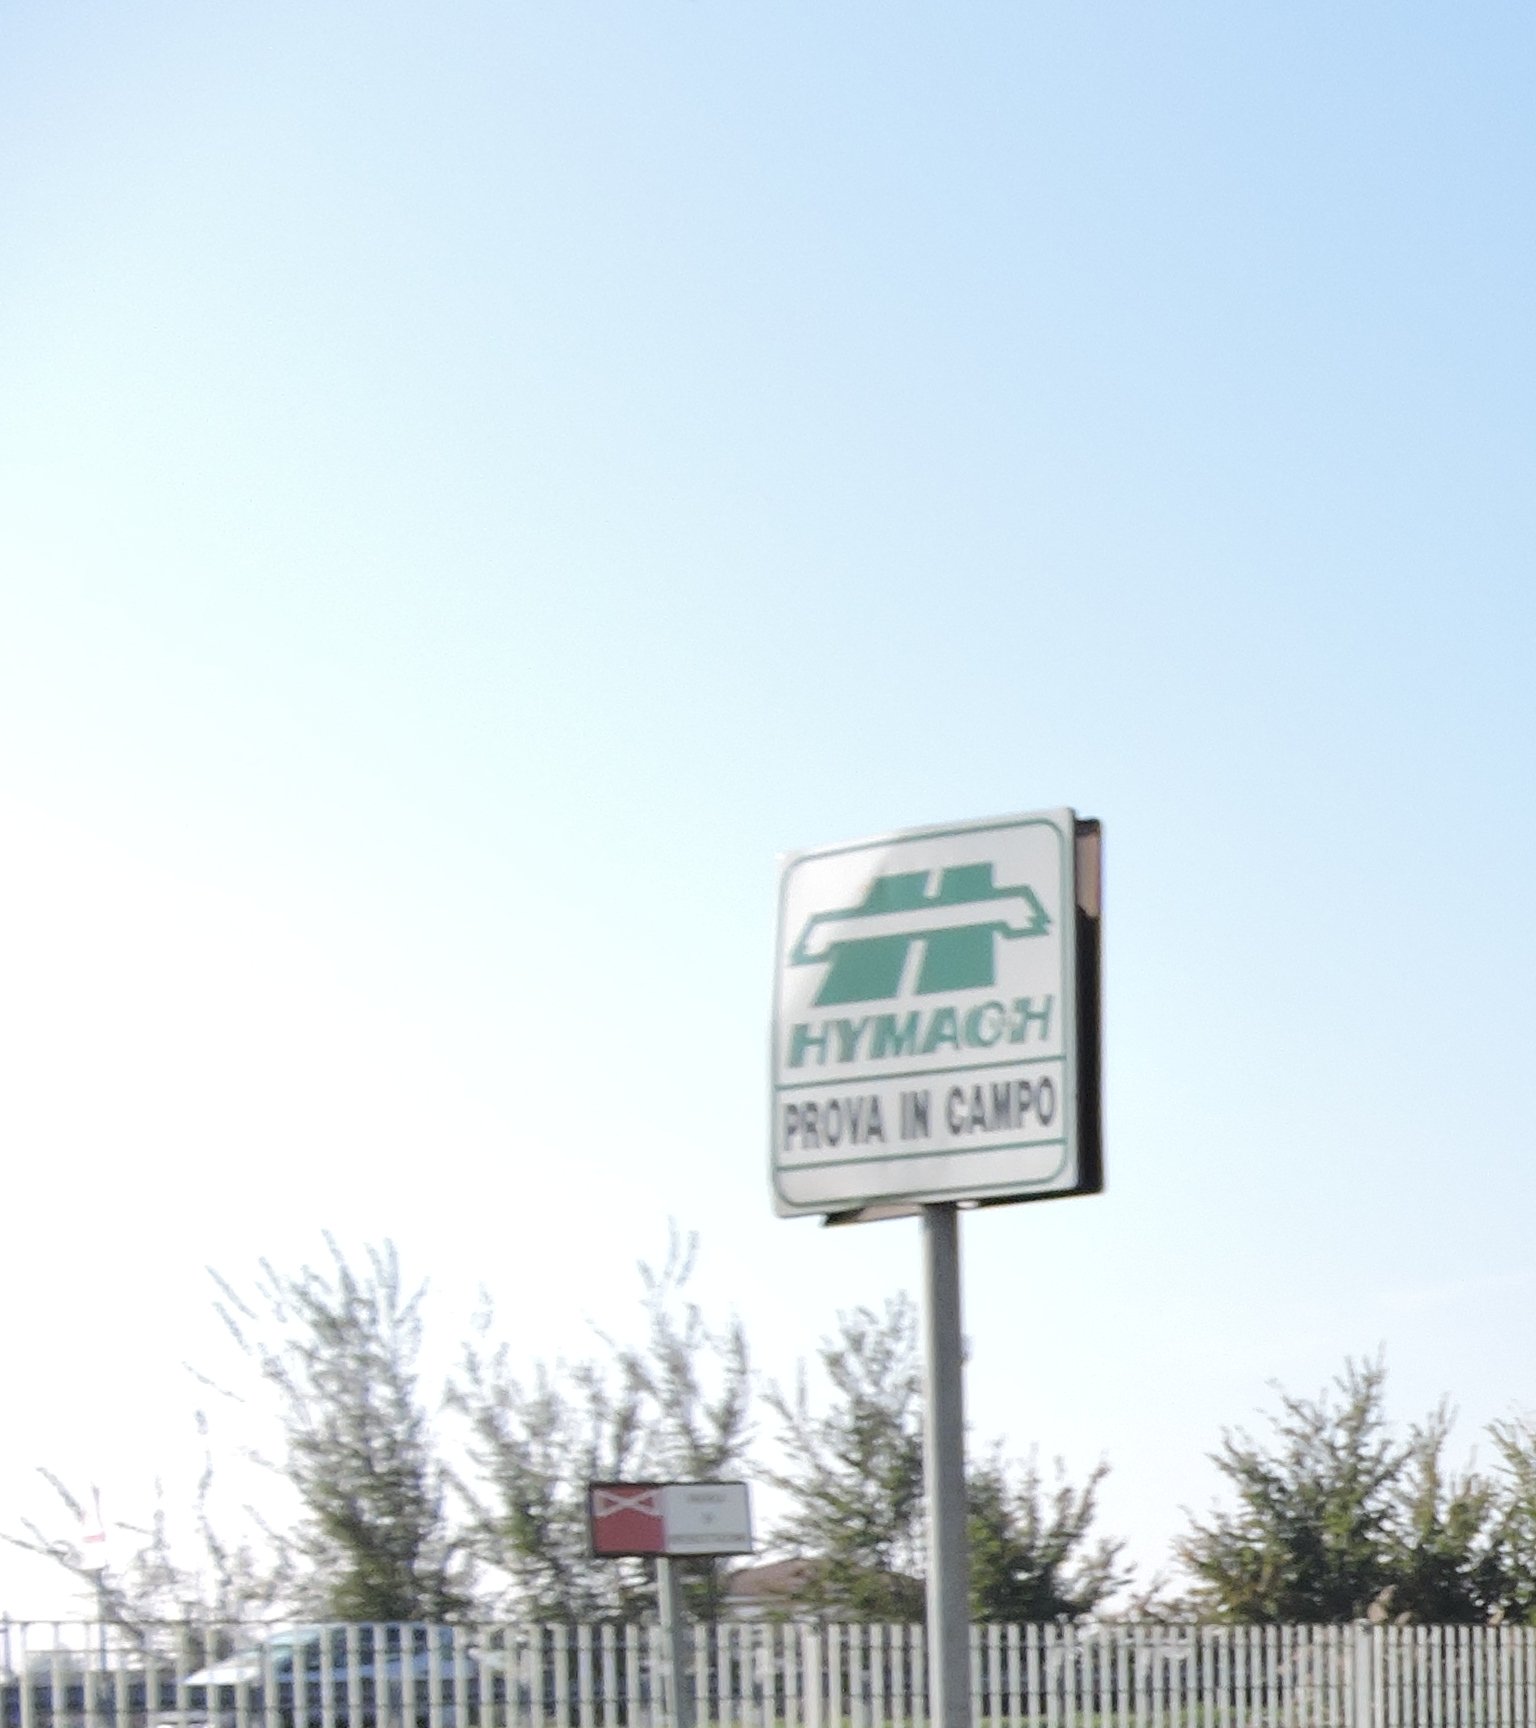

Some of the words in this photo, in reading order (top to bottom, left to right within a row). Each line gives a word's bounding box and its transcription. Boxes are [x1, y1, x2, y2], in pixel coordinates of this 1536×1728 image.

[787, 995, 1053, 1068] HYMACH
[783, 1094, 886, 1152] PROVA
[899, 1088, 931, 1141] IN
[944, 1076, 1057, 1136] CAMPO
